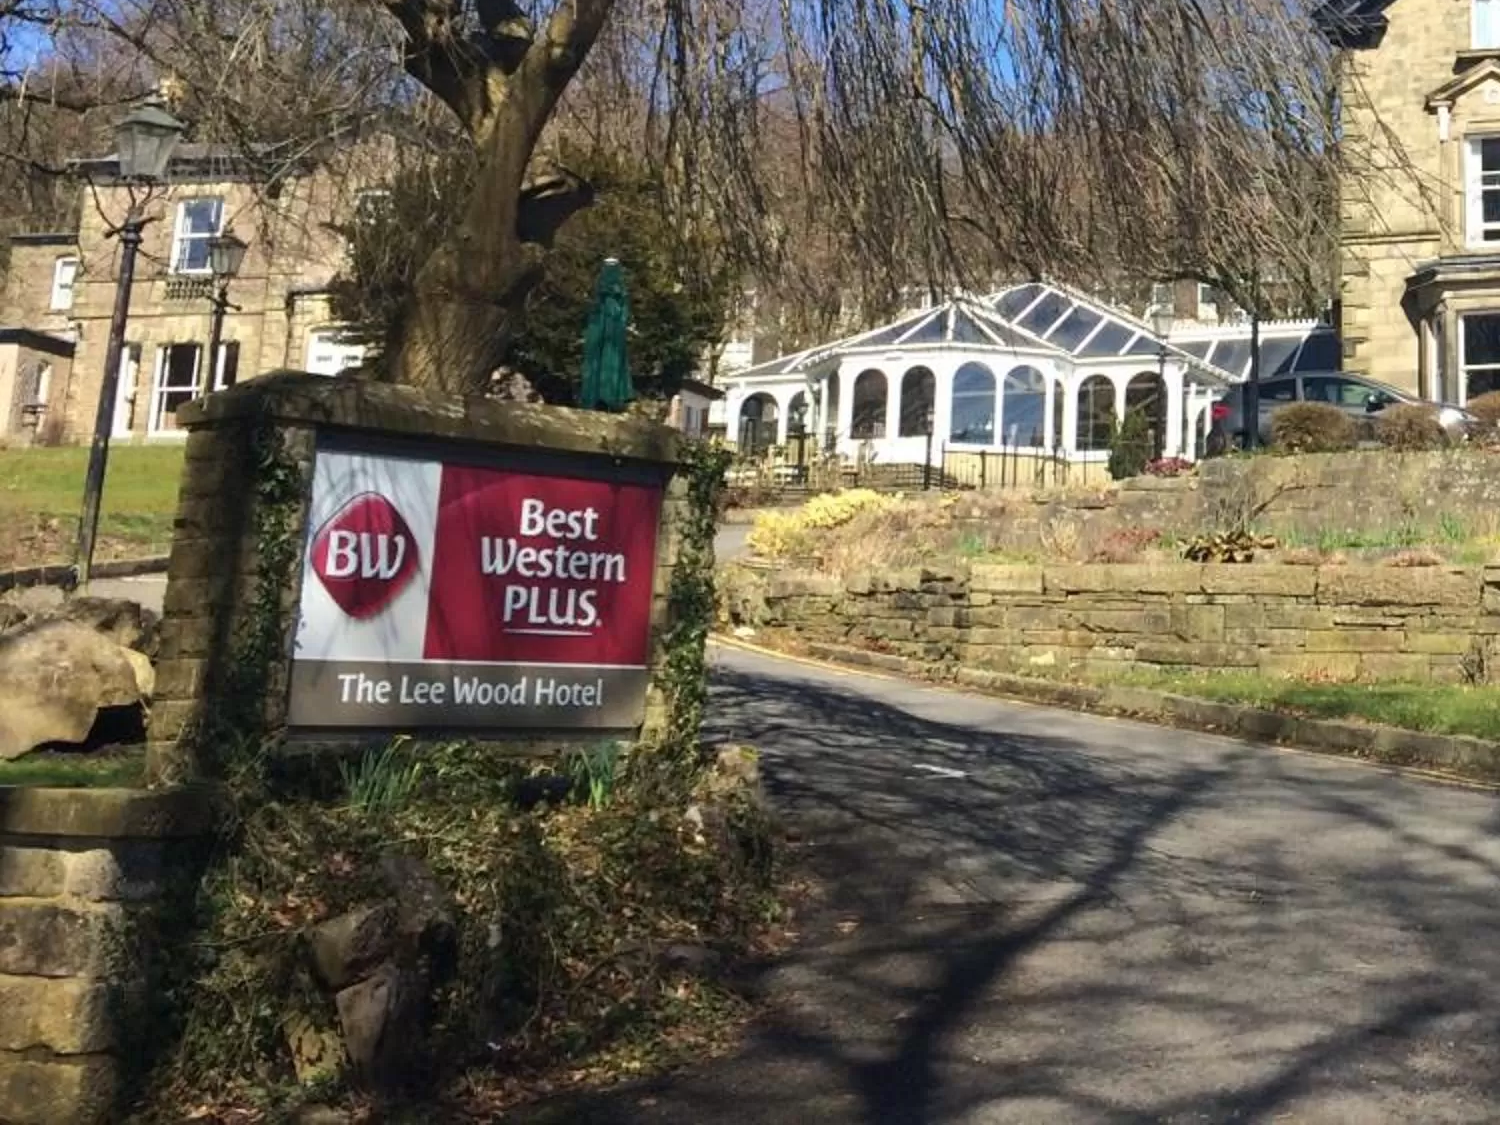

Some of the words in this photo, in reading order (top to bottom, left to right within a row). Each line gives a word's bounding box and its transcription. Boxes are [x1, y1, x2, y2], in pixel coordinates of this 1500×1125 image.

[519, 498, 599, 540] Best
[325, 530, 405, 579] BW
[481, 536, 626, 581] Western
[338, 672, 392, 704] The
[400, 675, 446, 705] Lee
[453, 676, 527, 706] Wood
[534, 677, 603, 707] Hotel
